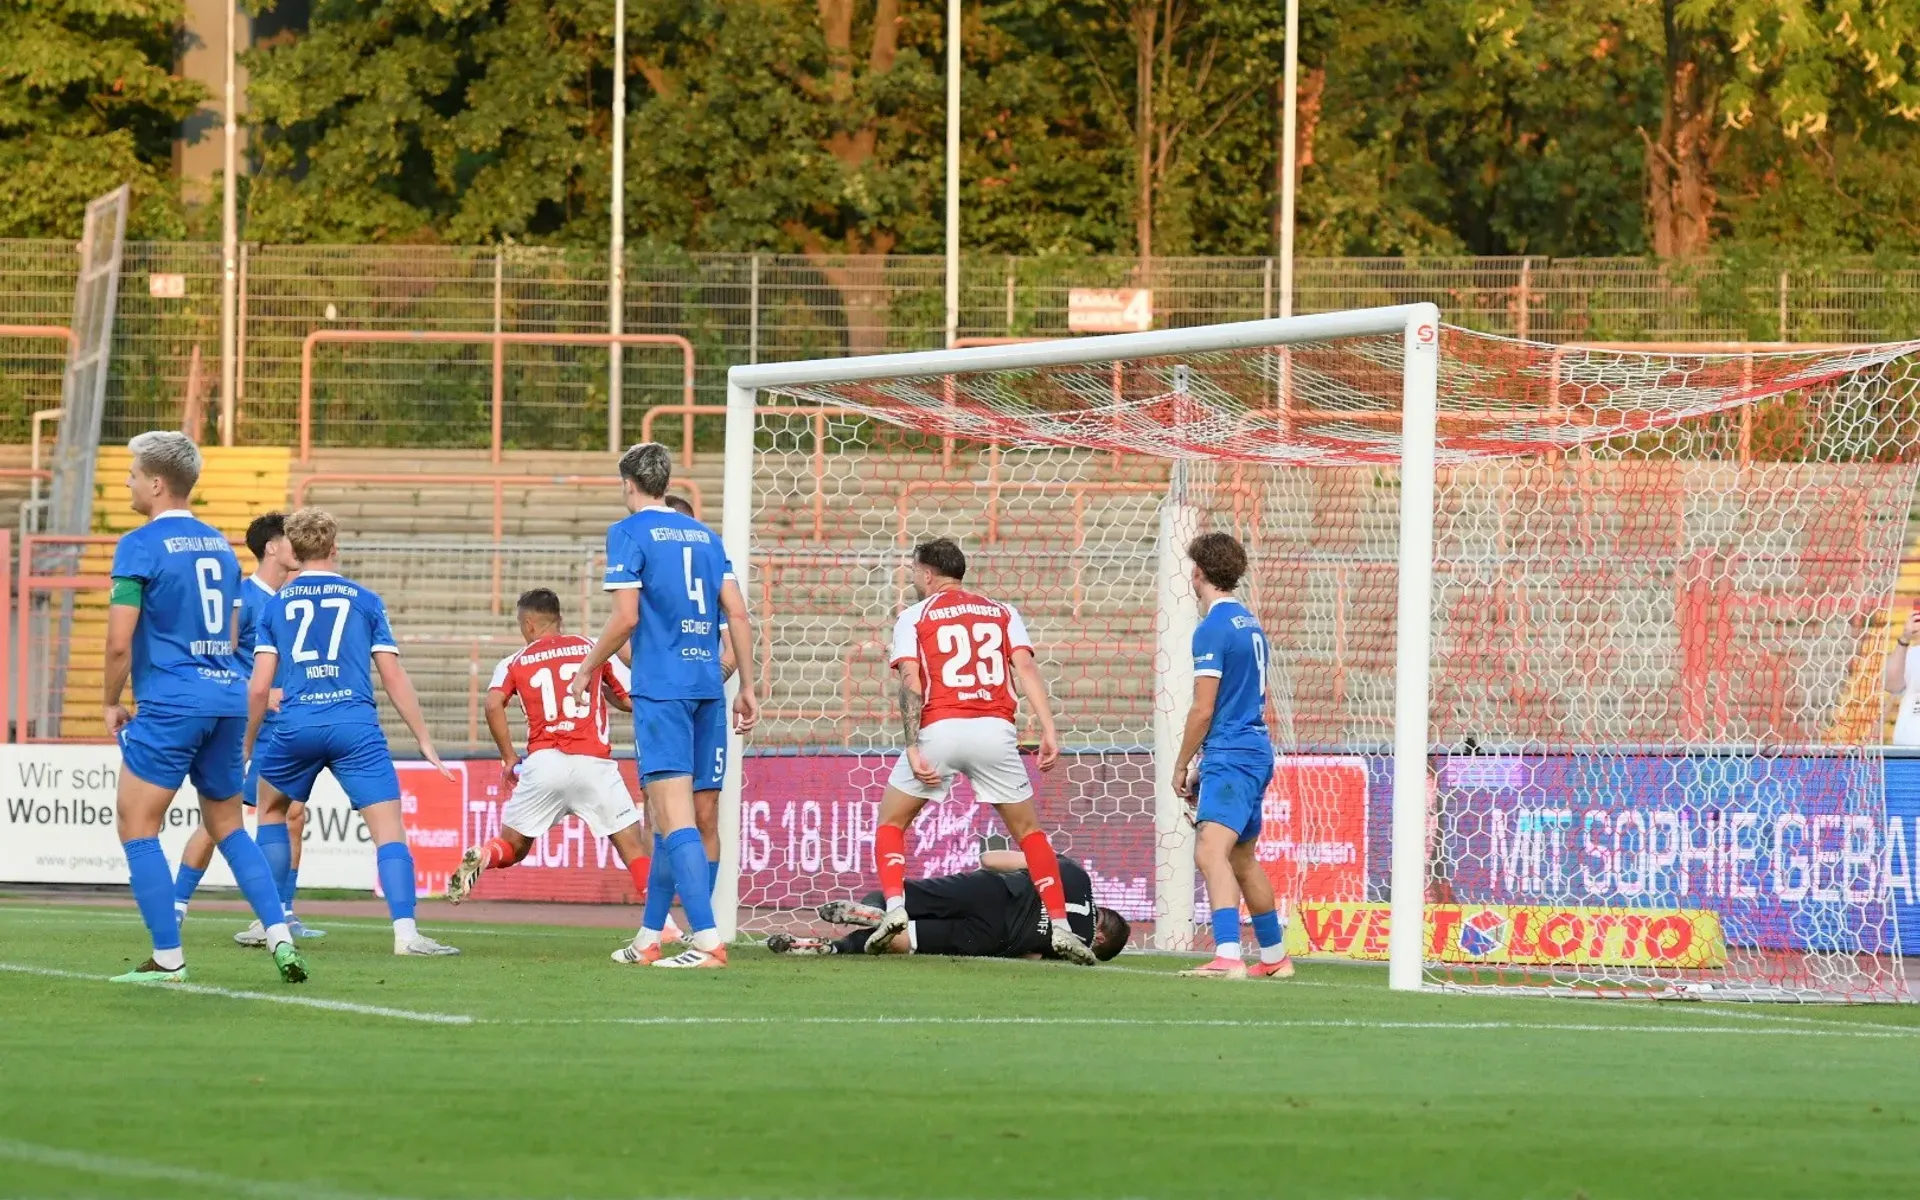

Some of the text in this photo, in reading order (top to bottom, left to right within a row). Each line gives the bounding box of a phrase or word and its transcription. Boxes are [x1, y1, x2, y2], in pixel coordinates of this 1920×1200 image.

[195, 557, 223, 634] 6
[683, 547, 706, 614] 4
[285, 598, 350, 663] 27
[928, 603, 1001, 621] OBERHAUSEN
[520, 645, 592, 666] OBERHAUSEN
[937, 623, 1004, 687] 23
[530, 663, 590, 722] 13
[19, 762, 62, 788] Wir
[8, 799, 201, 832] Wohlbeen
[739, 800, 771, 871] IS
[782, 800, 821, 873] 18
[831, 801, 880, 874] UH
[1490, 808, 1573, 893] MIT
[1583, 808, 1762, 899] SOPHIE
[1306, 909, 1692, 961] WET LOTTO
